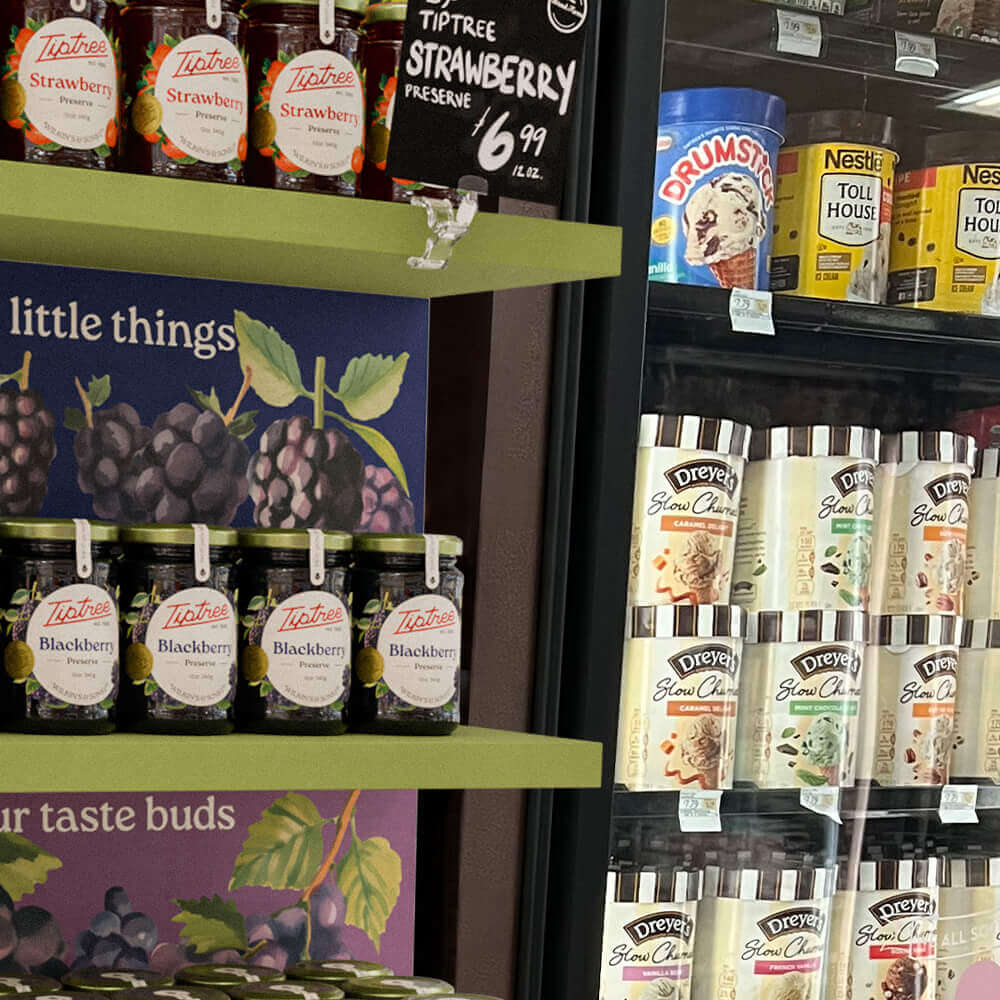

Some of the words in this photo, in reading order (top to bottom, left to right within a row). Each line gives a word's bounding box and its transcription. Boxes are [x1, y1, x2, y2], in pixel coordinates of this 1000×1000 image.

[419, 9, 497, 42] TIPTREE
[35, 33, 108, 63] Tiptree
[172, 49, 241, 78] Tiptree
[29, 72, 113, 101] Strawberry
[286, 64, 356, 93] Tiptree
[406, 39, 576, 116] STRAWBERRY
[166, 87, 244, 115] Strawberry
[405, 84, 471, 109] PRESERVE
[280, 101, 360, 128] Strawberry
[662, 136, 774, 208] DRUMSTICK
[838, 182, 873, 201] TOLL
[827, 202, 877, 221] HOUSE
[9, 295, 103, 342] little
[111, 306, 237, 359] things
[647, 491, 690, 516] Slow
[43, 596, 113, 627] Tiptree
[161, 600, 230, 630] Tiptree
[277, 602, 344, 632] Tiptree
[393, 606, 456, 635] Tiptree
[39, 636, 114, 656] Blackberry
[157, 639, 233, 658] Blackberry
[272, 641, 346, 659] Blackberry
[389, 643, 457, 661] Blackberry
[653, 677, 695, 702] Slow
[776, 679, 817, 701] Slow
[40, 802, 136, 833] taste
[145, 795, 236, 832] buds
[633, 916, 690, 939] Dreyer's
[609, 943, 651, 966] Slow
[741, 939, 783, 961] Slow
